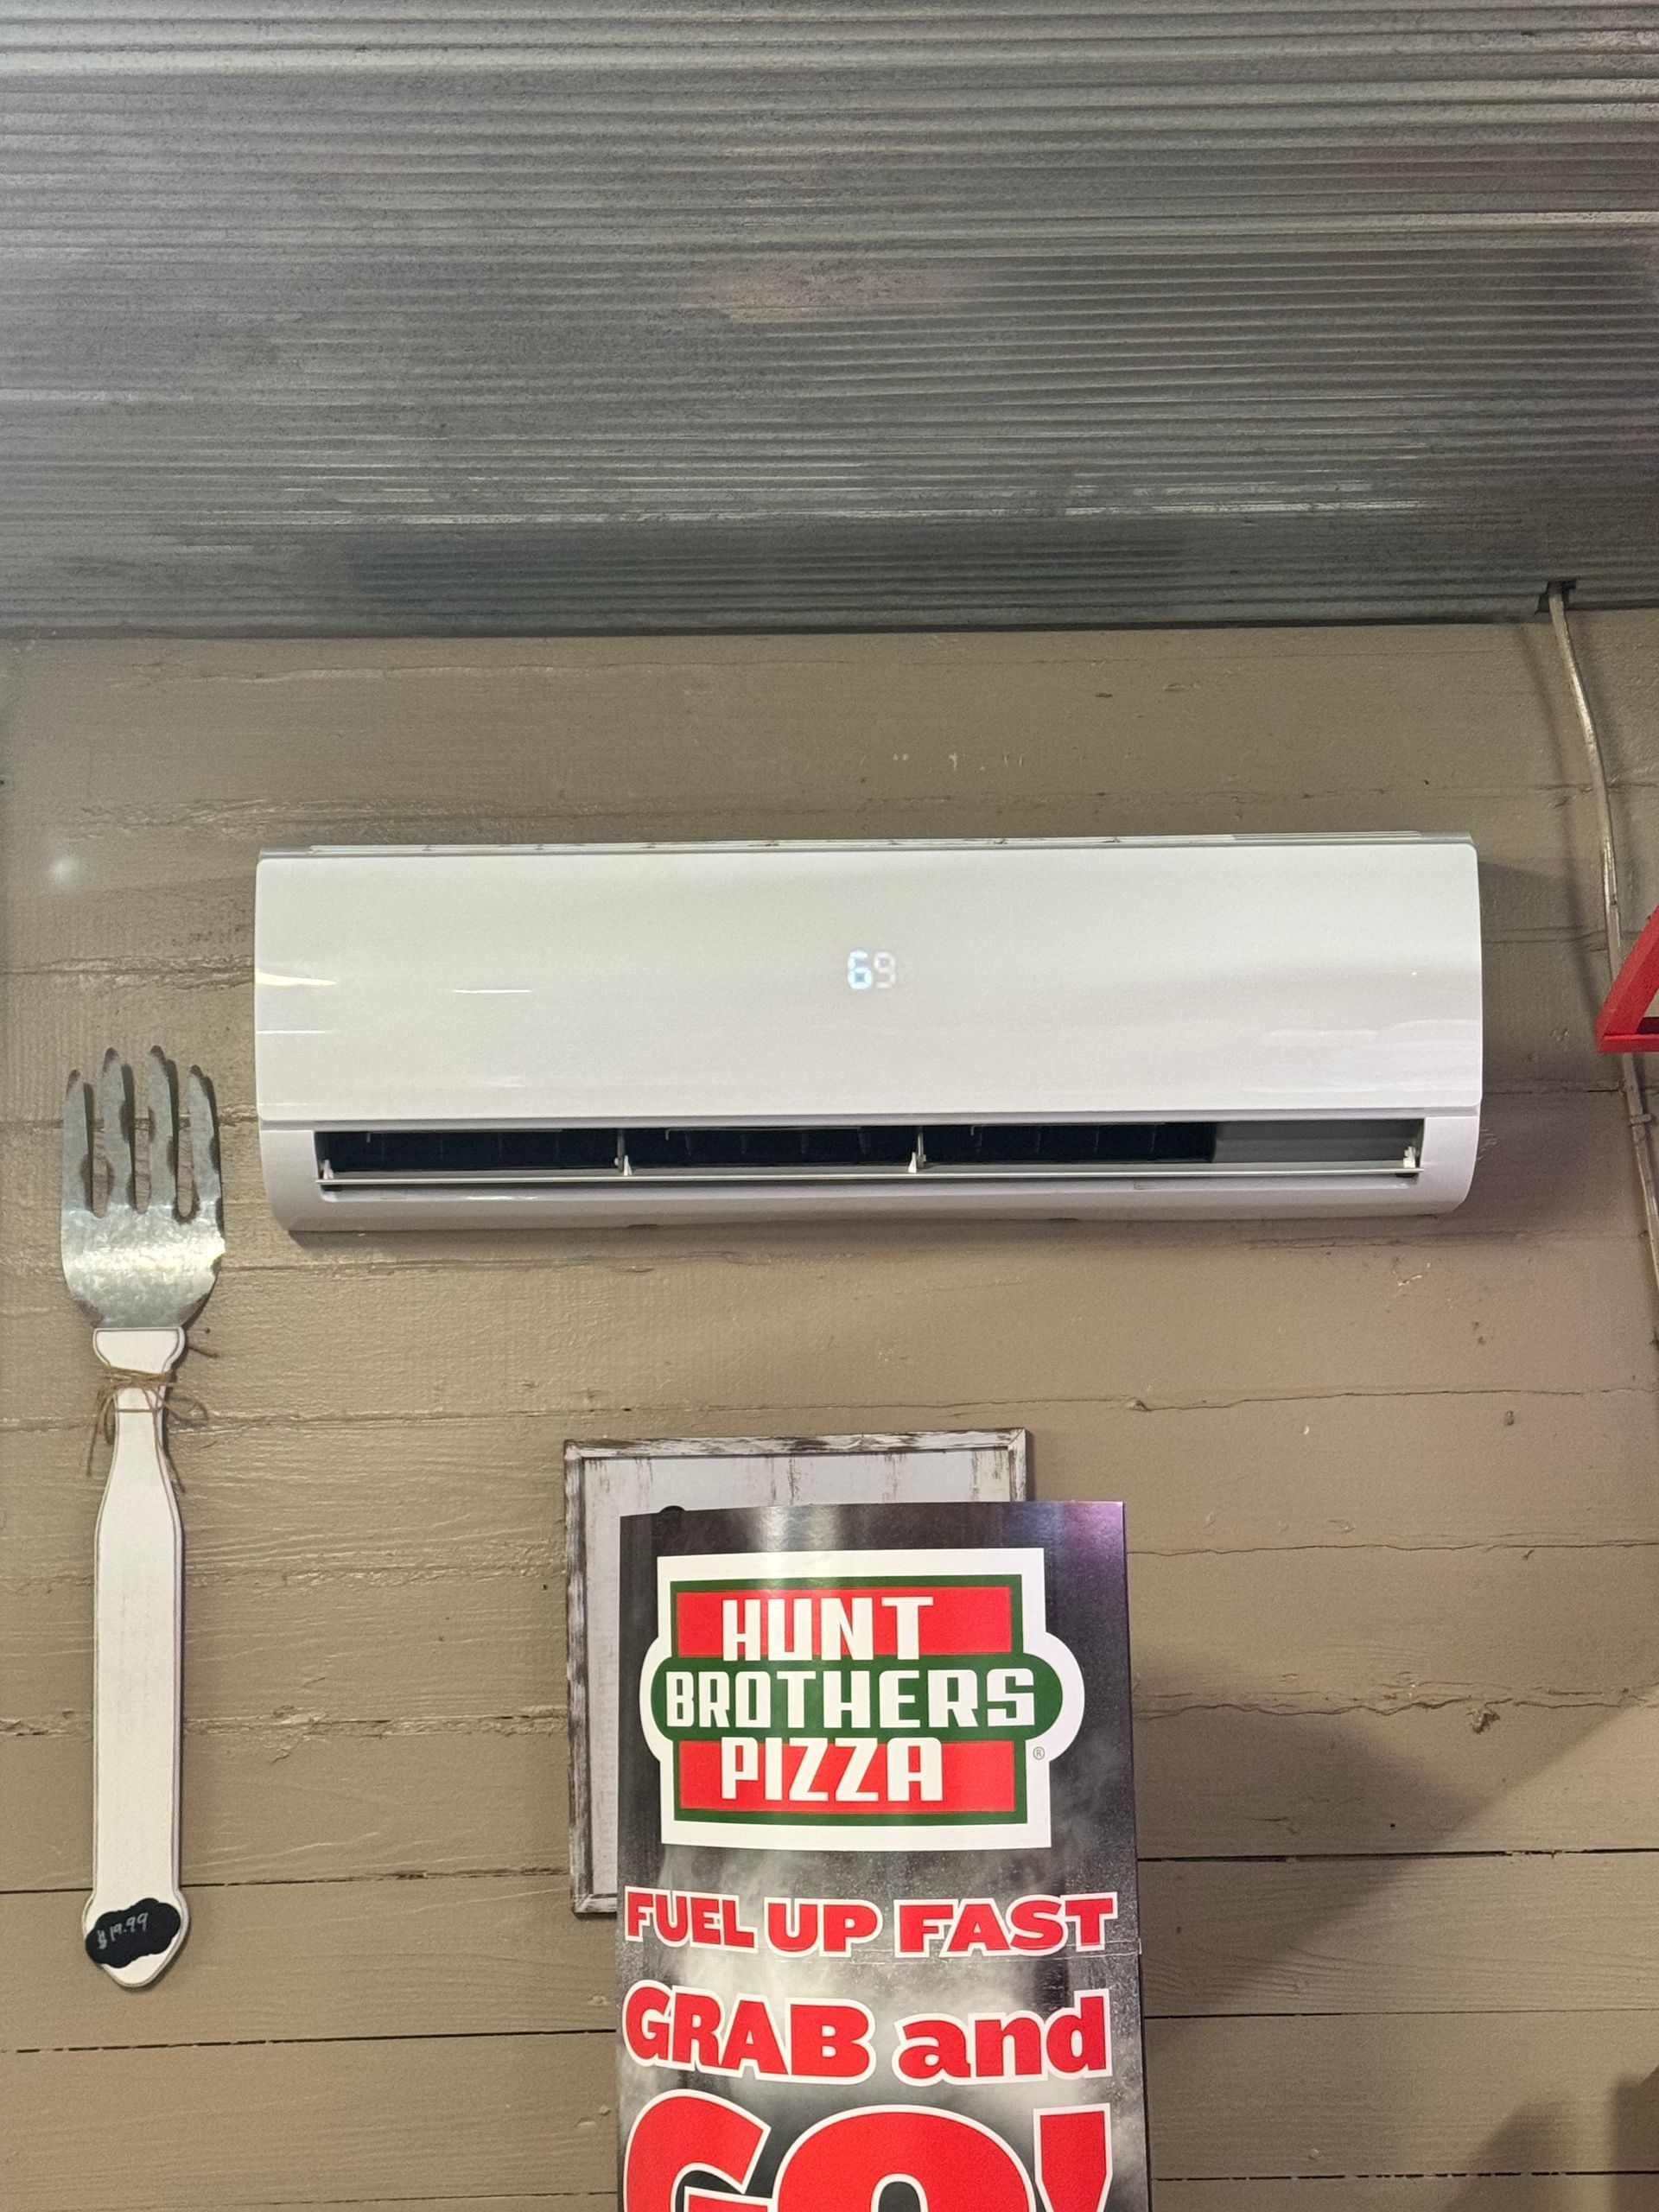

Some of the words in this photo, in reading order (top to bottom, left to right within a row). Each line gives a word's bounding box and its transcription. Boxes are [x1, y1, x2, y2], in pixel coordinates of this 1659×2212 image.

[847, 950, 897, 990] 69
[721, 1596, 934, 1662] HUNT
[665, 1668, 1036, 1729] BROTHERS
[720, 1736, 944, 1802] PIZZA
[96, 1911, 149, 1950] $19.99
[624, 1886, 758, 1951] FUEL
[765, 1897, 882, 1958] UP
[894, 1891, 1119, 1958] FAST
[622, 1980, 877, 2085] GRAB
[892, 1988, 1113, 2087] and
